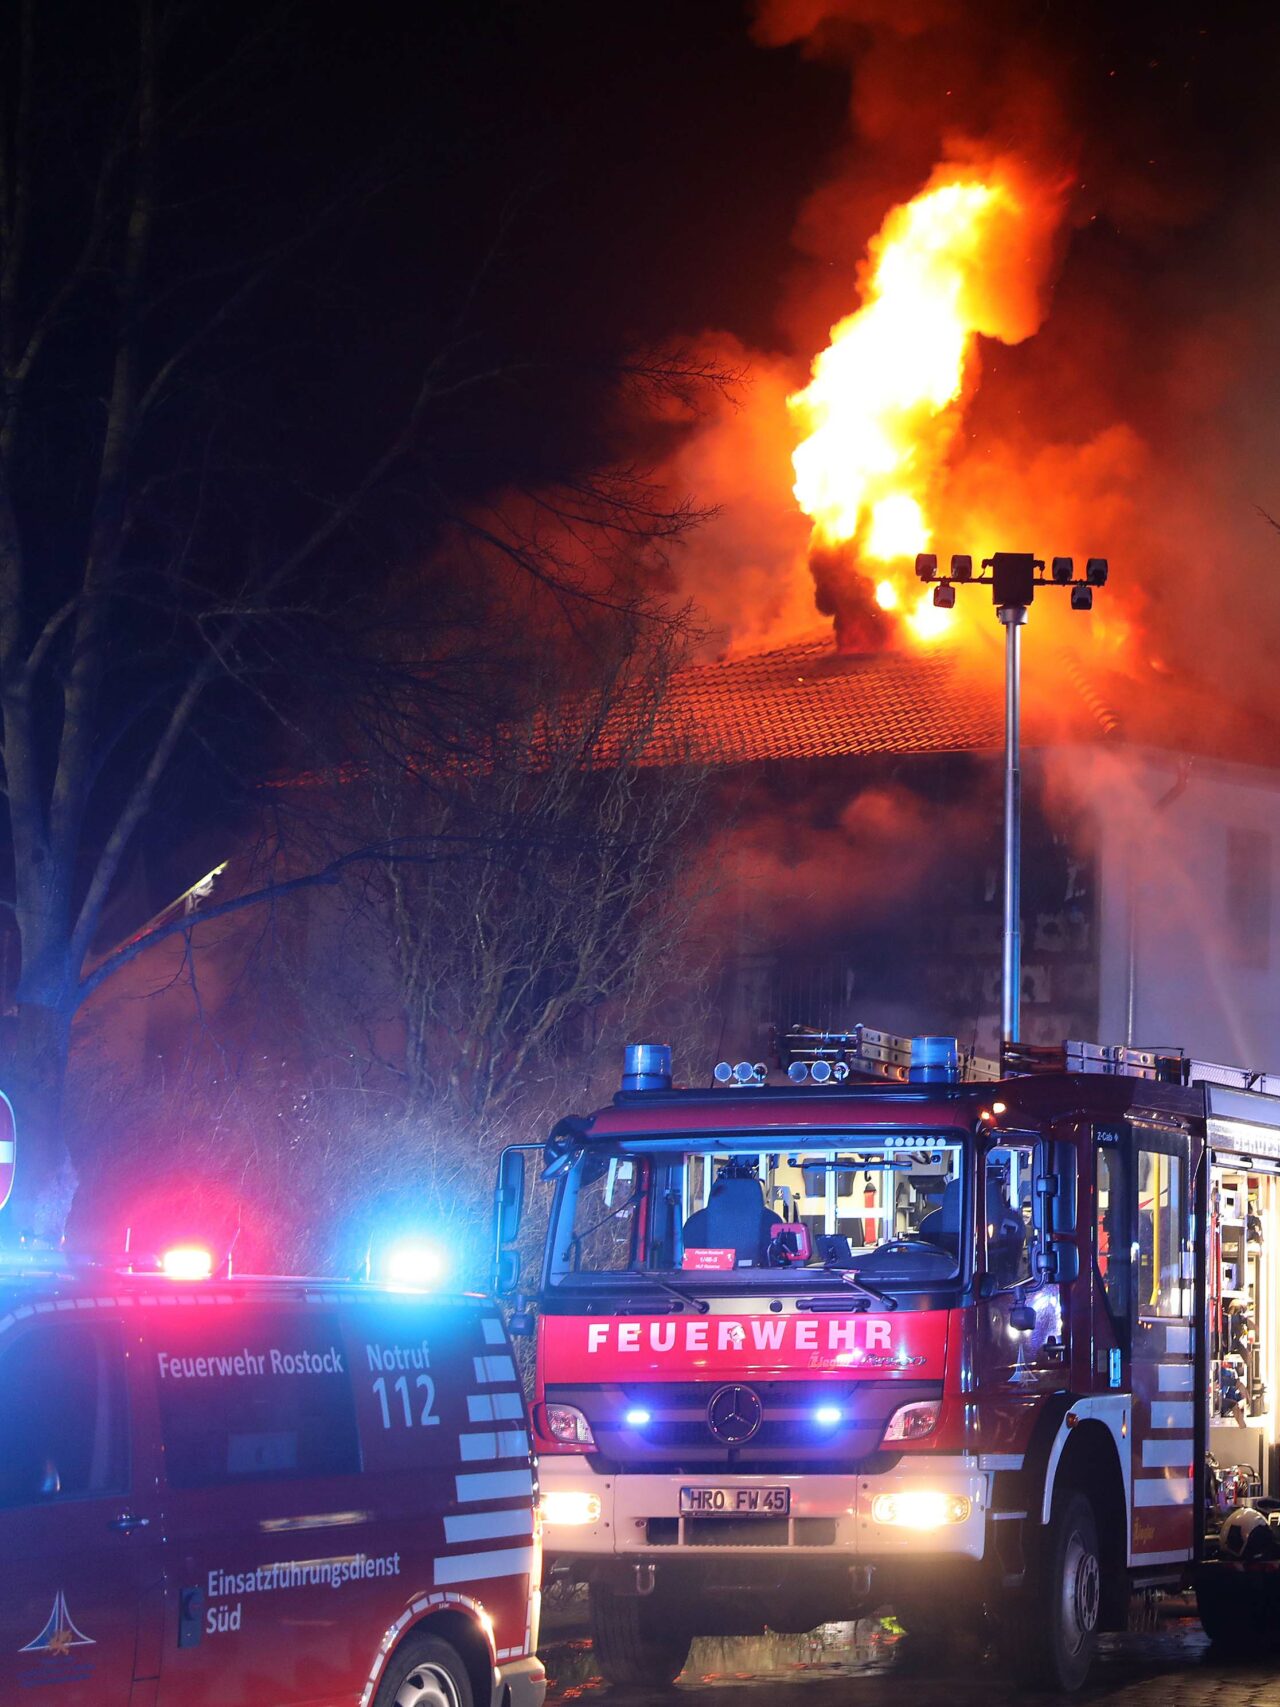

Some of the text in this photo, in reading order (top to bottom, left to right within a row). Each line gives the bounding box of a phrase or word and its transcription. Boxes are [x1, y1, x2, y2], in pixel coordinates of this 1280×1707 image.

[587, 1319, 892, 1353] FEUERWEHR
[157, 1347, 344, 1378] Feuerwehr Rostock
[366, 1340, 431, 1371] Notruf
[372, 1373, 441, 1429] 112
[690, 1490, 785, 1510] HRO FW 45
[208, 1552, 400, 1597] Einsatzführungsdienst
[205, 1603, 242, 1634] Süd
